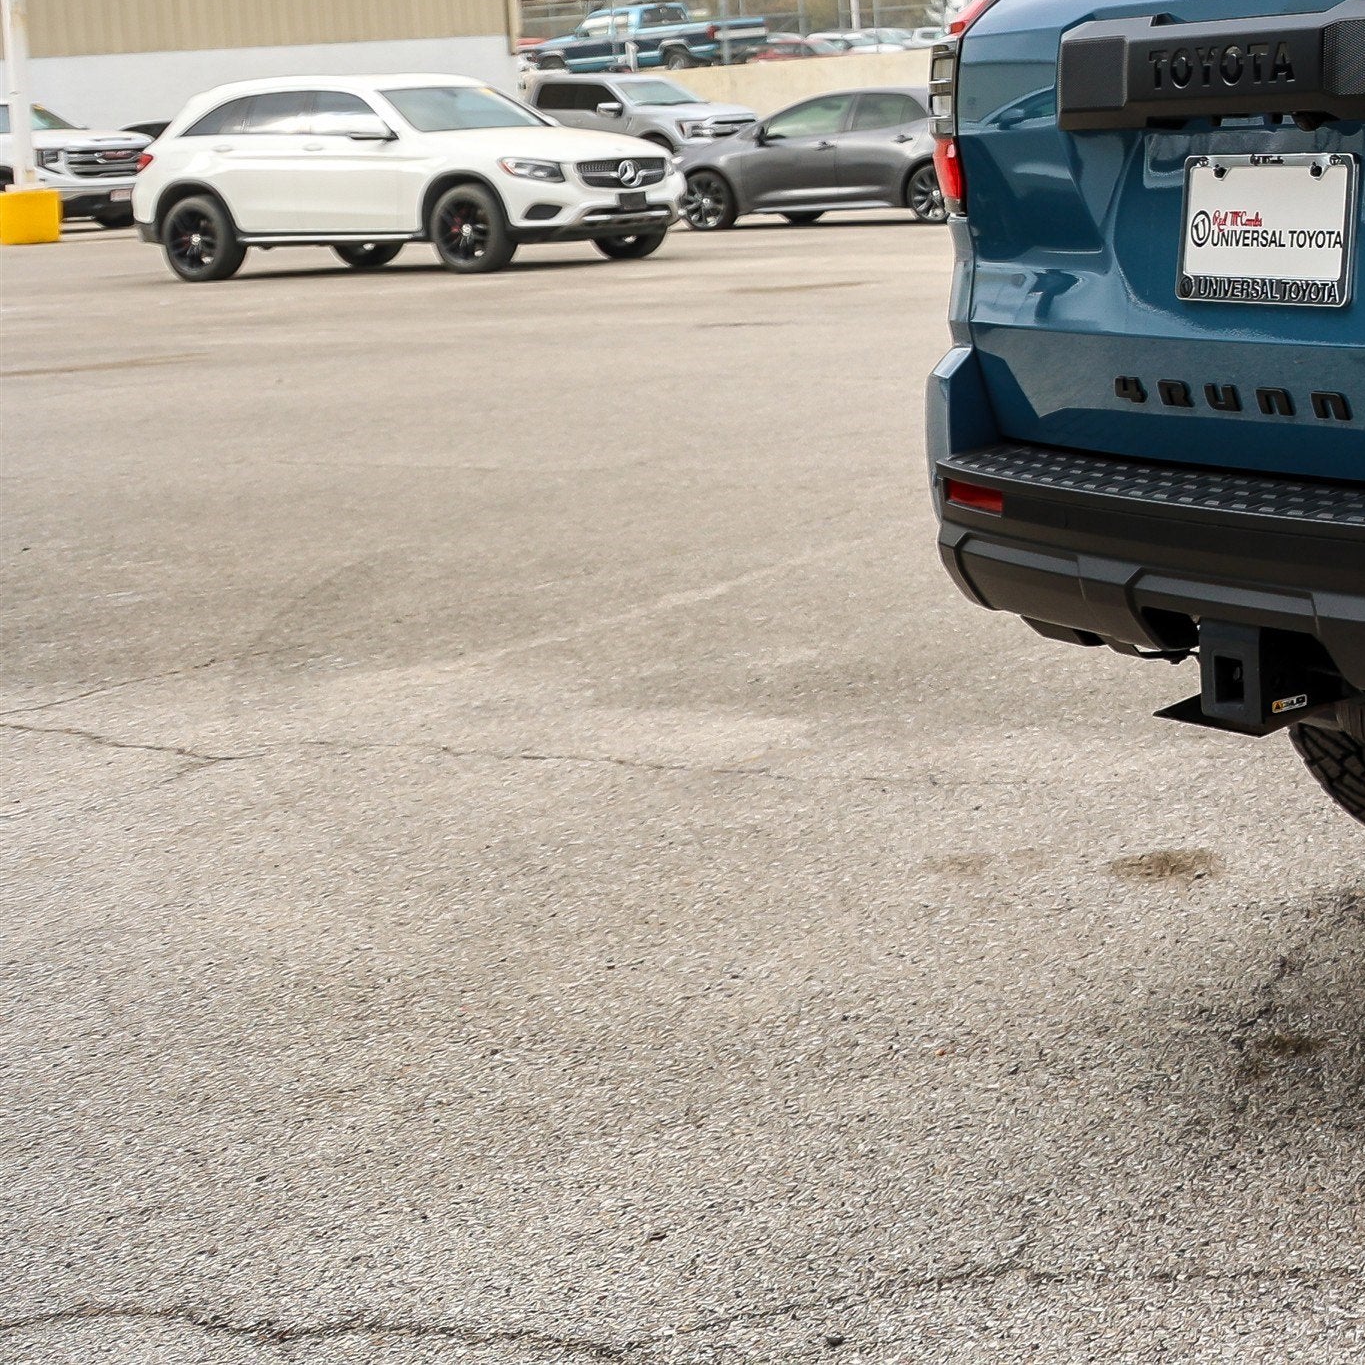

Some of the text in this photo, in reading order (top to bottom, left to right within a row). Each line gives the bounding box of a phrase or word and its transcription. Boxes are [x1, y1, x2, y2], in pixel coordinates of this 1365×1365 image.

[1148, 41, 1295, 90] TOYOTA
[1212, 210, 1227, 232] Red
[1211, 230, 1343, 249] UNIVERSAL TOYOTA
[1198, 276, 1280, 300] UNIVERSAL
[1281, 280, 1340, 303] TOYOTA
